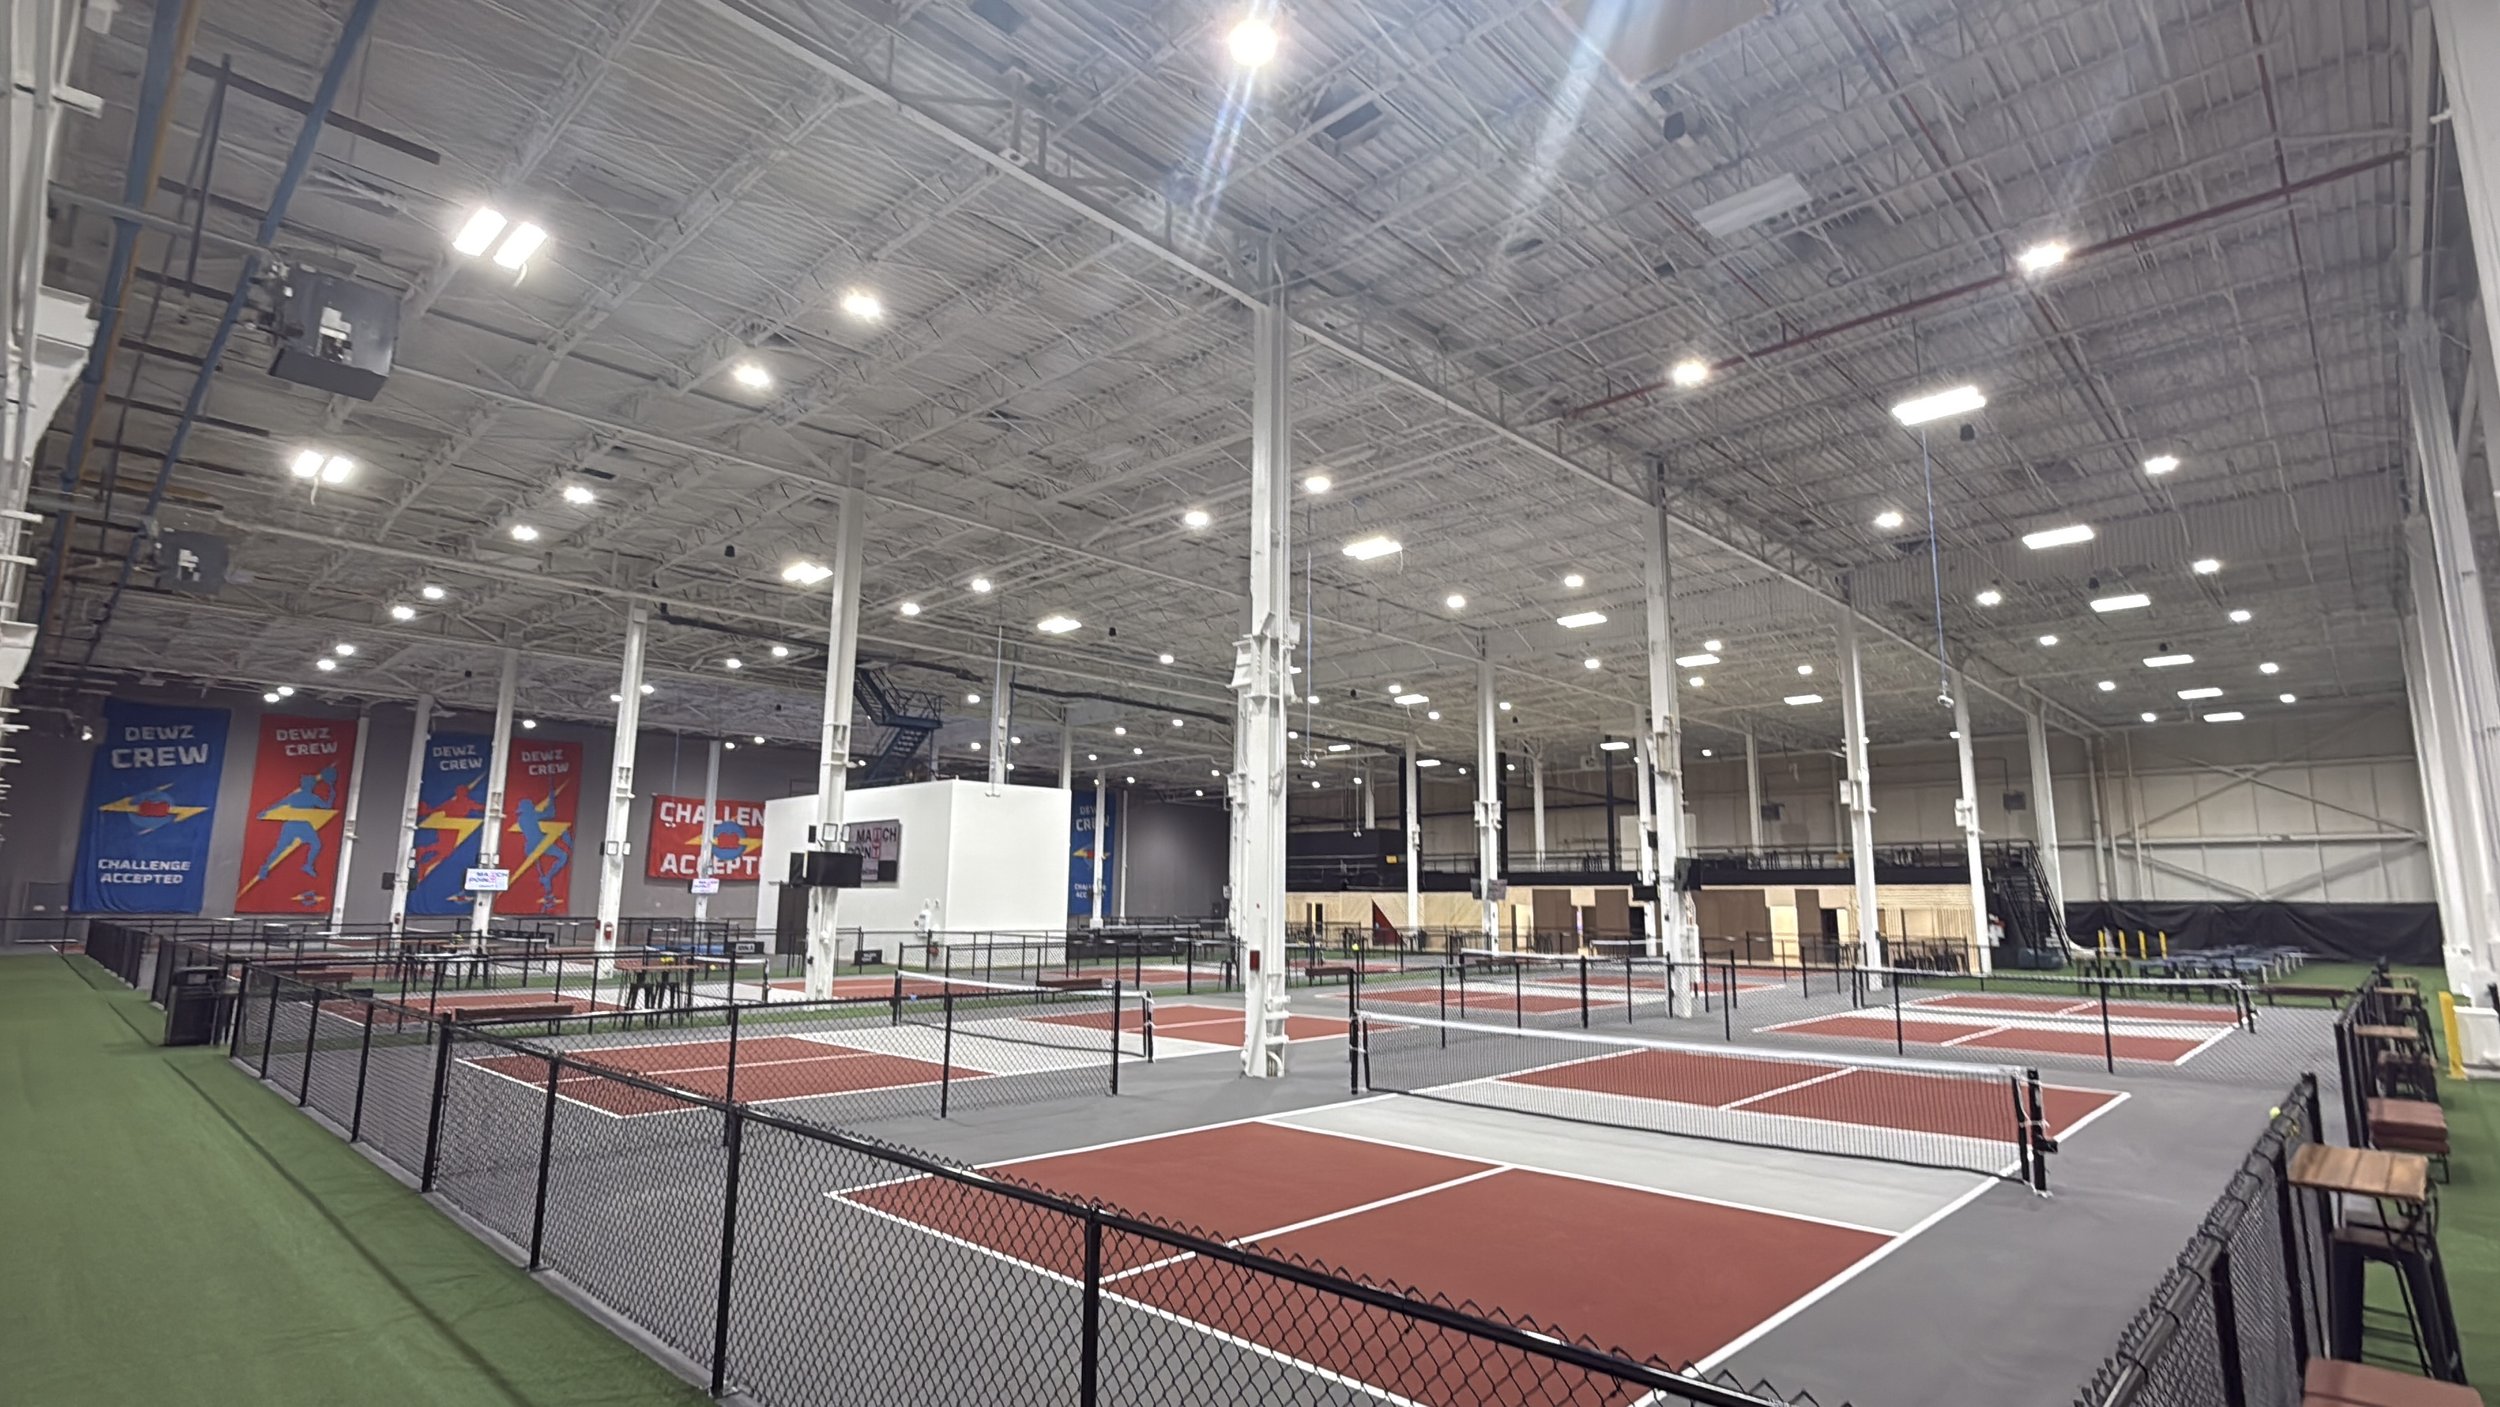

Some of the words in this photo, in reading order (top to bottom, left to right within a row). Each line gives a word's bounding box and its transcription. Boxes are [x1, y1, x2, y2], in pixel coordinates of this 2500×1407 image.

[125, 725, 195, 741] DEWZ
[276, 727, 331, 741] DEWZ
[285, 741, 338, 756] CREW
[432, 744, 477, 757] DEWZ
[521, 749, 563, 762] DEWZ
[111, 743, 209, 769] CREW
[440, 757, 483, 771] CREW
[529, 762, 569, 776] CREW
[660, 801, 764, 827] CHALLEN
[856, 827, 897, 843] MATCH
[98, 858, 191, 871] CHALLENGE
[660, 853, 762, 876] ACEPT
[100, 872, 183, 884] ACCEPTED
